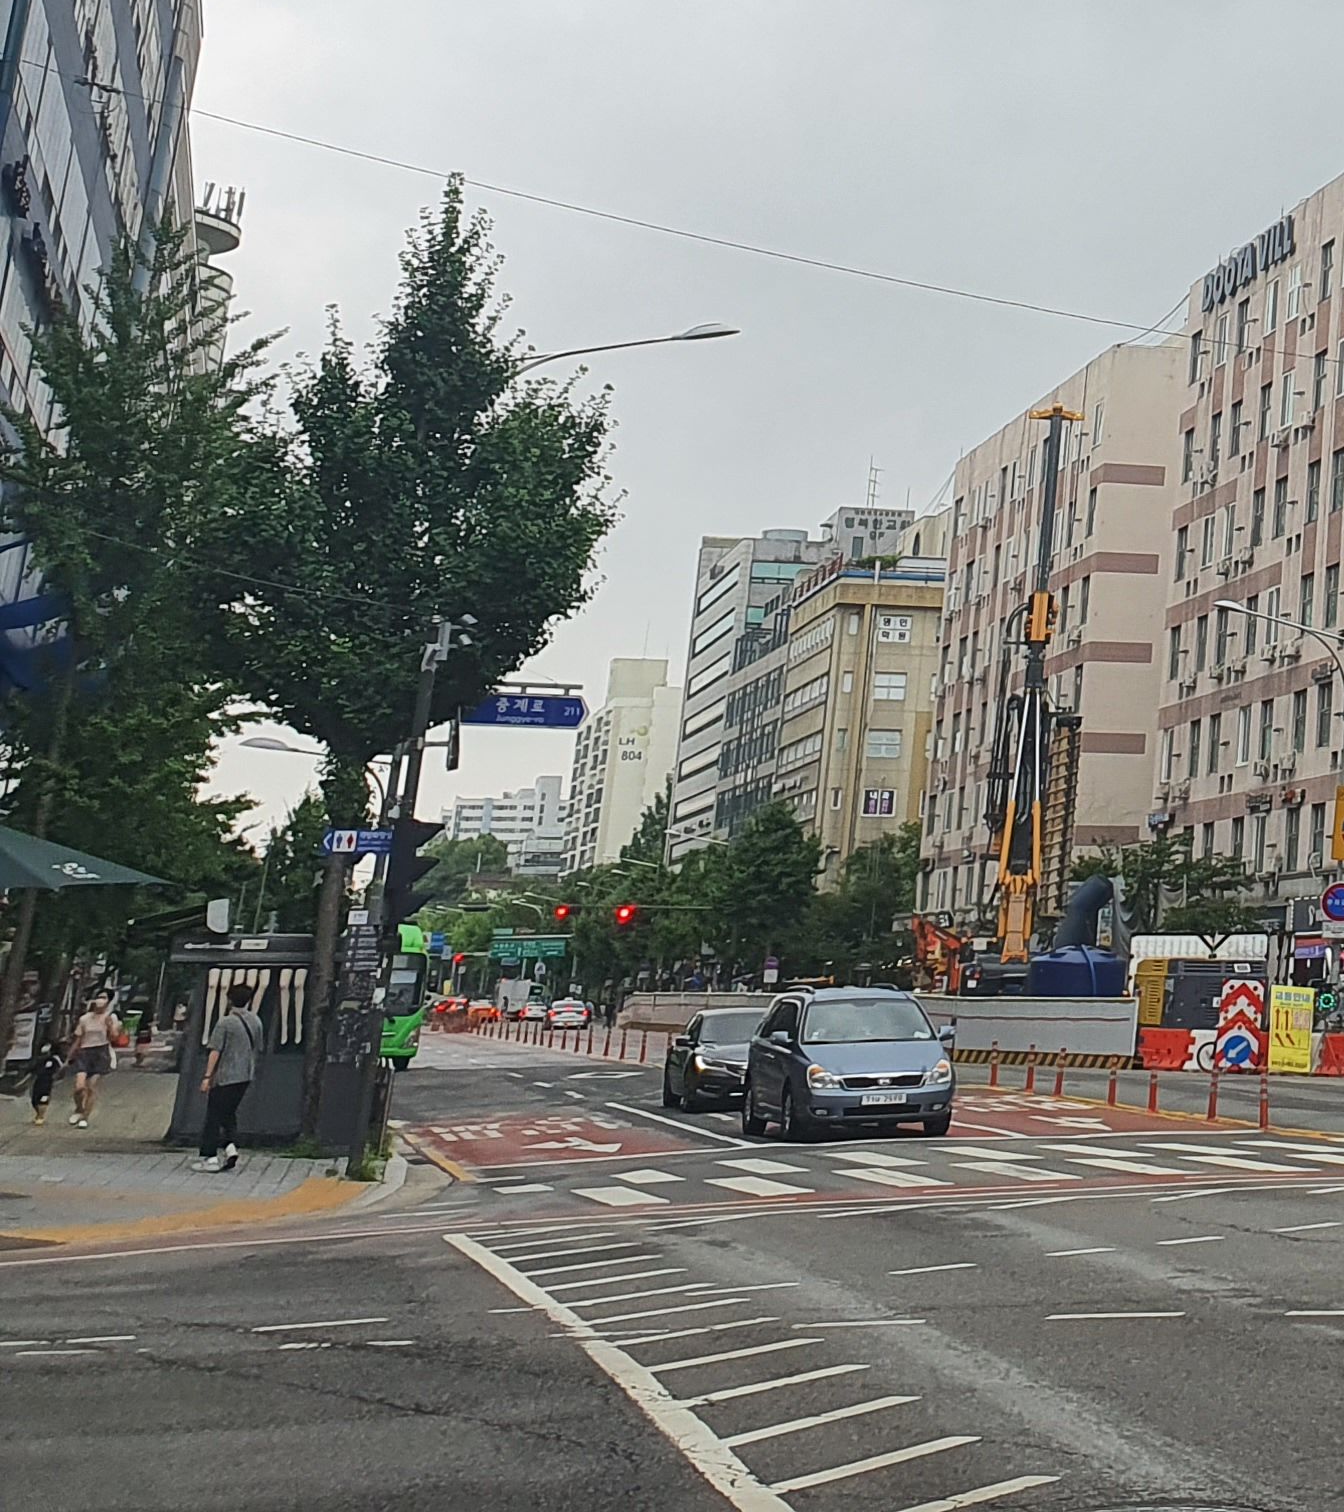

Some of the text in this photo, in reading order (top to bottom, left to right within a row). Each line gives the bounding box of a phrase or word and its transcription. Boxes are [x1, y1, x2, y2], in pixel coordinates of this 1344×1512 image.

[496, 696, 545, 714] 중계로
[619, 737, 636, 746] LH
[621, 750, 642, 761] 804
